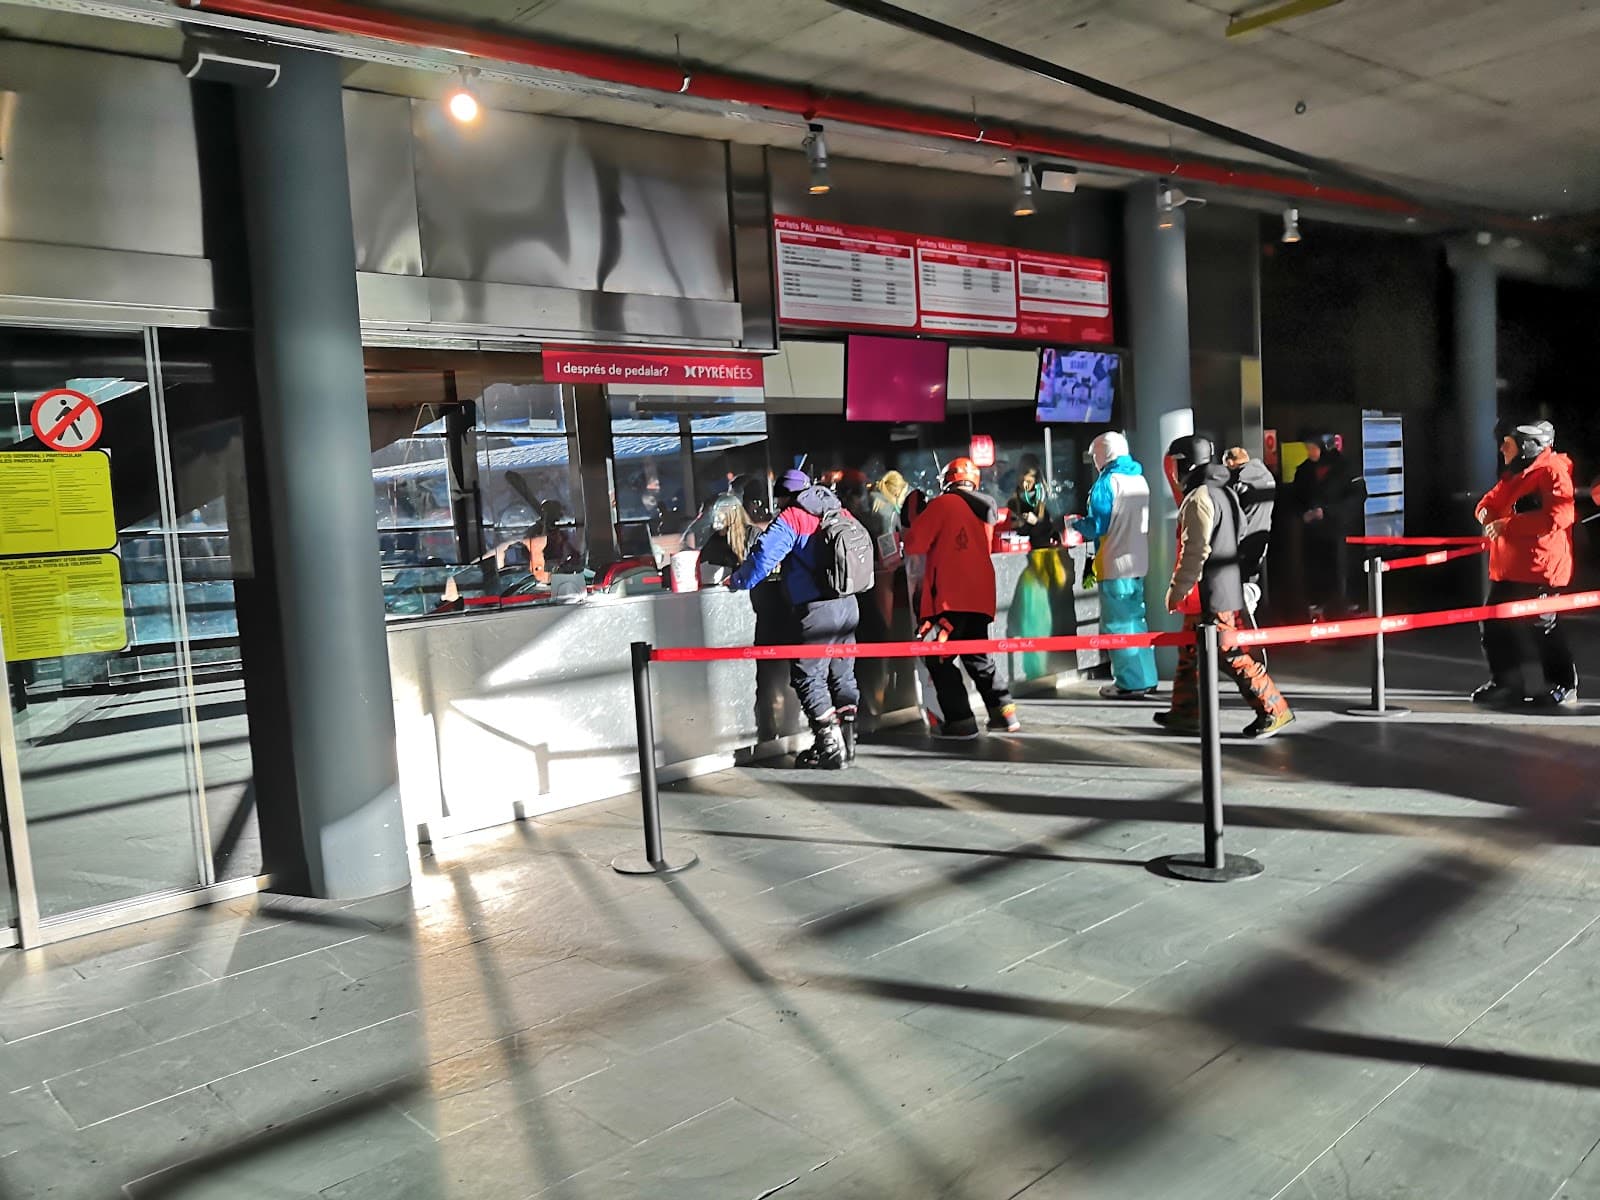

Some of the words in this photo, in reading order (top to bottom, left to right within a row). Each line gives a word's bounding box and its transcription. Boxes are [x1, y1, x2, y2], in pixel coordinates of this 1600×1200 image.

[563, 362, 606, 377] després
[608, 364, 622, 376] de
[625, 365, 669, 378] pedalar?
